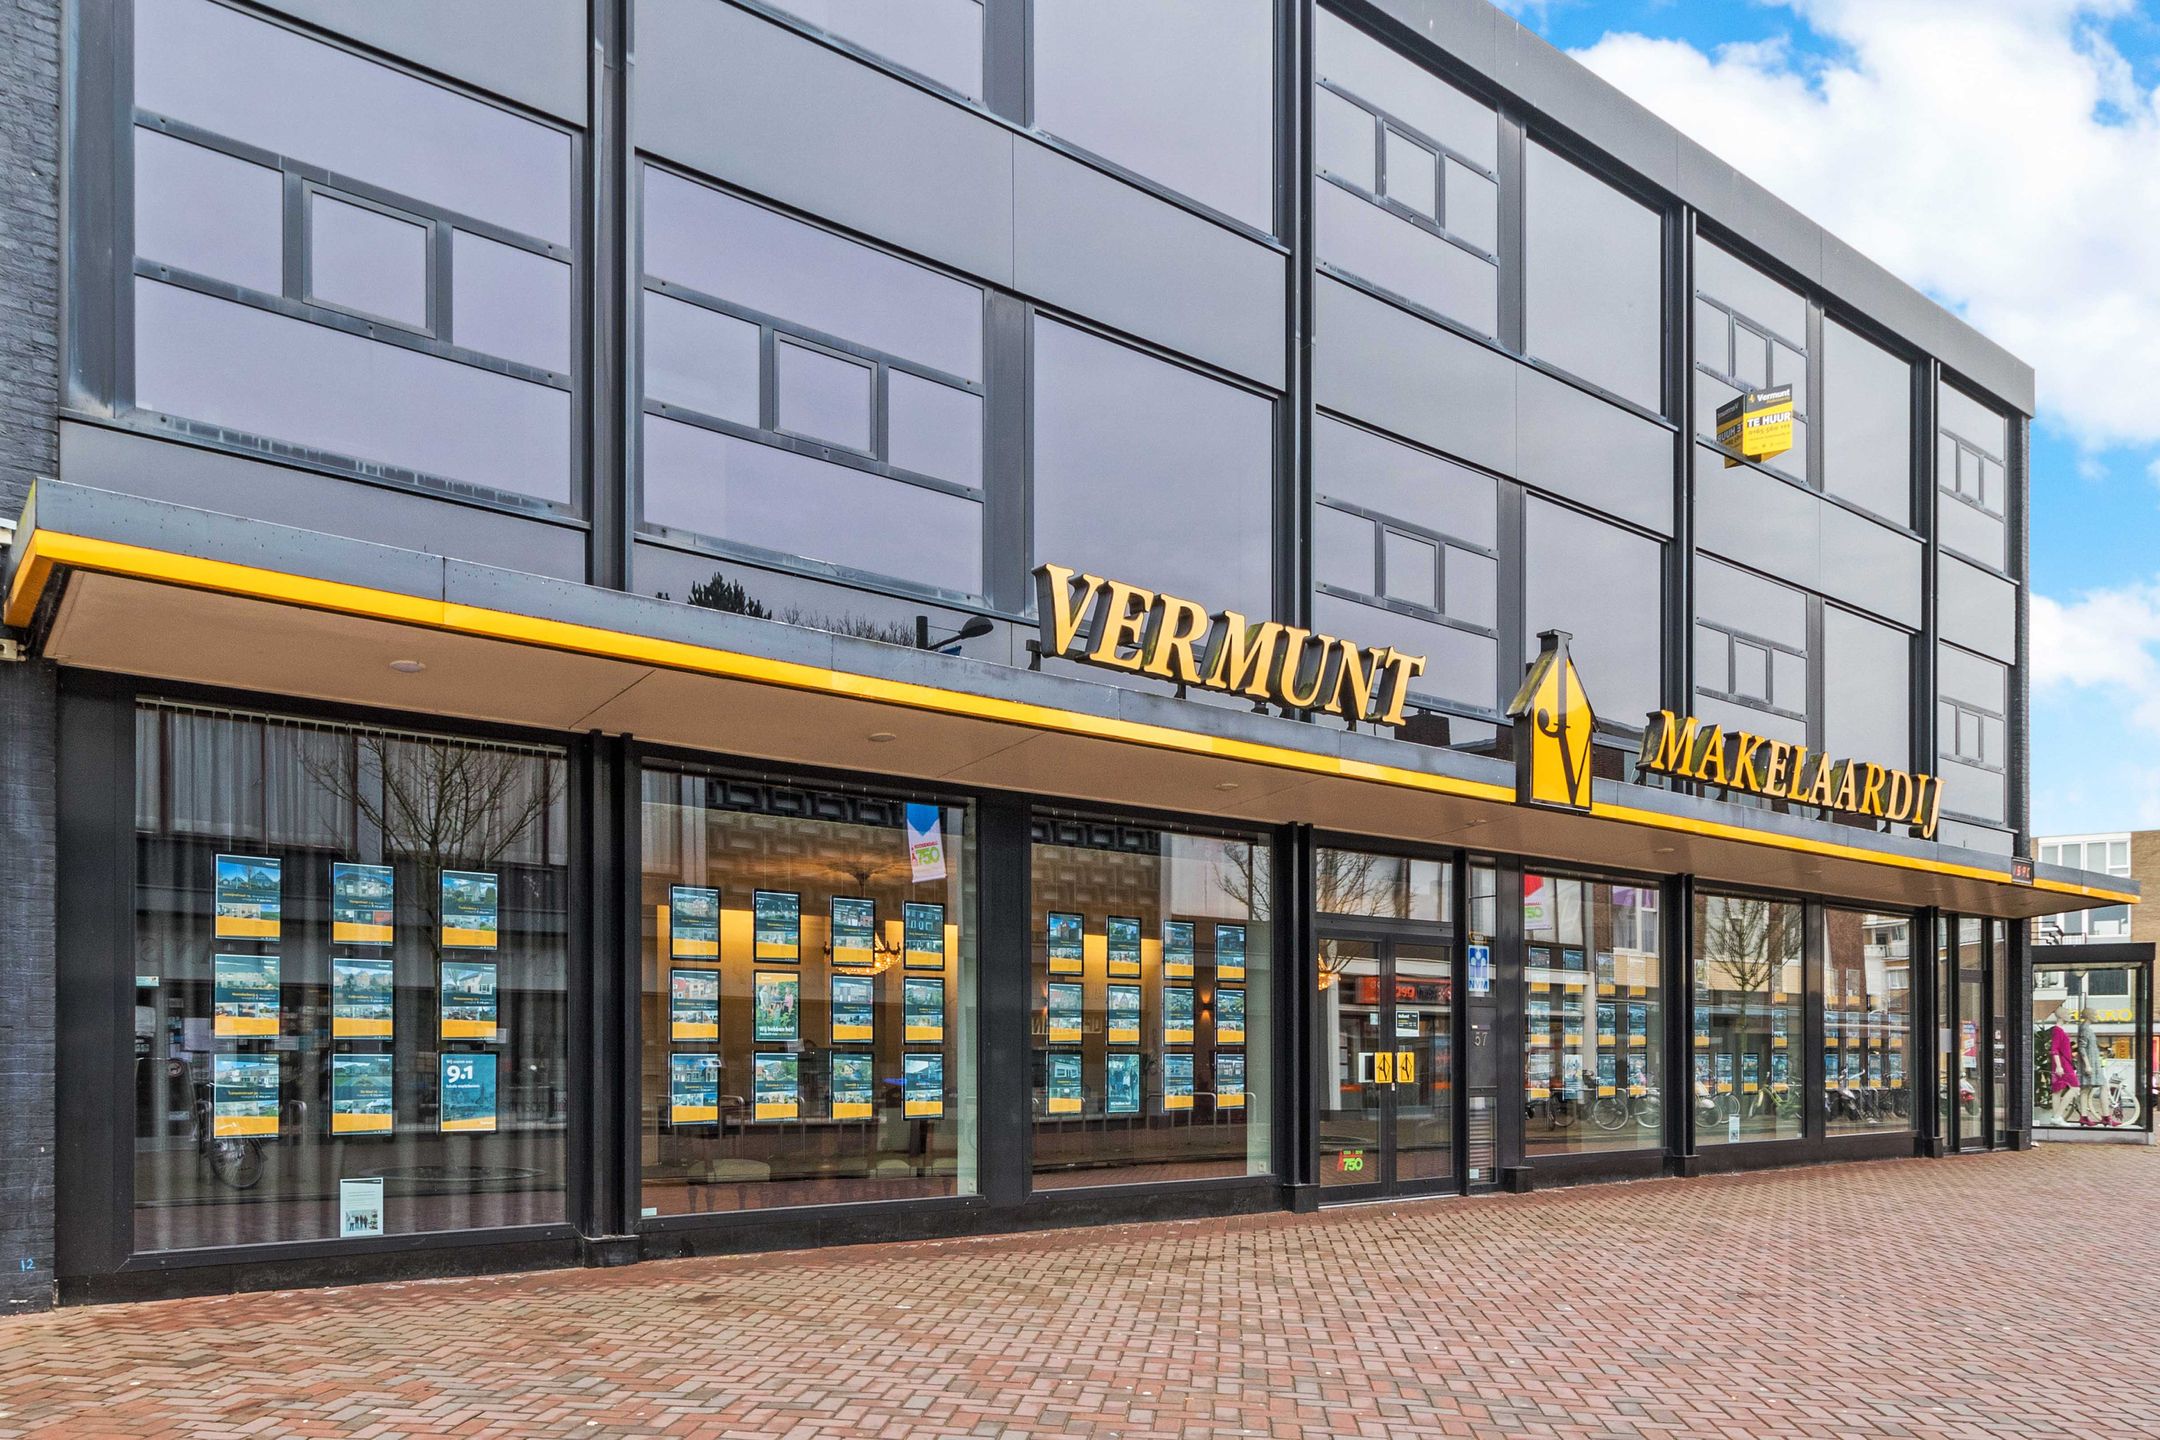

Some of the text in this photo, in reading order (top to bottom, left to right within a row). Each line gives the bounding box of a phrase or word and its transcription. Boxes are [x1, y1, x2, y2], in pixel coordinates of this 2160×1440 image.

[1747, 417, 1761, 428] TE
[1761, 411, 1792, 425] HUUR
[1040, 562, 1427, 726] VERMUNT
[1648, 709, 1946, 840] MAKELAARDIJ
[916, 847, 940, 865] 750
[1469, 980, 1489, 990] NVM
[1474, 1032, 1488, 1047] 57
[446, 1065, 473, 1083] 9.1
[1343, 1158, 1363, 1171] 750
[21, 1258, 36, 1272] 12
